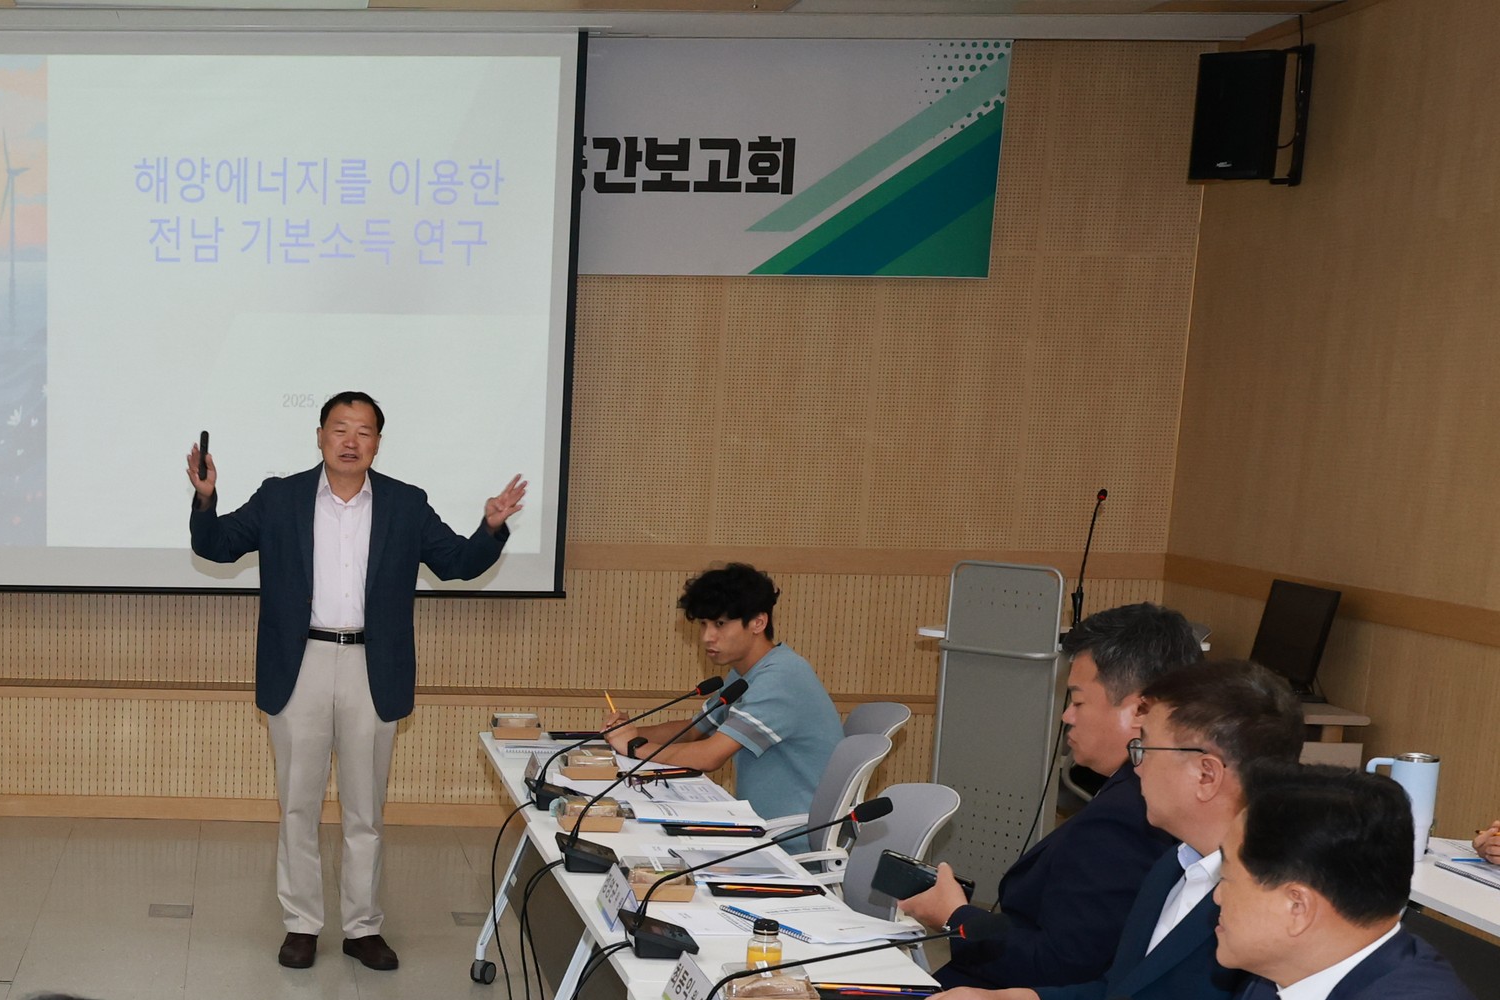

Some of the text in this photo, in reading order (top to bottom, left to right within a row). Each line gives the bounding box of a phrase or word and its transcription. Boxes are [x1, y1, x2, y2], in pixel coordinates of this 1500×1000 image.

[133, 156, 506, 207] 해양에너지를 이용한
[580, 136, 796, 195] 간보고회
[148, 215, 488, 267] 전남 기본소득 연구
